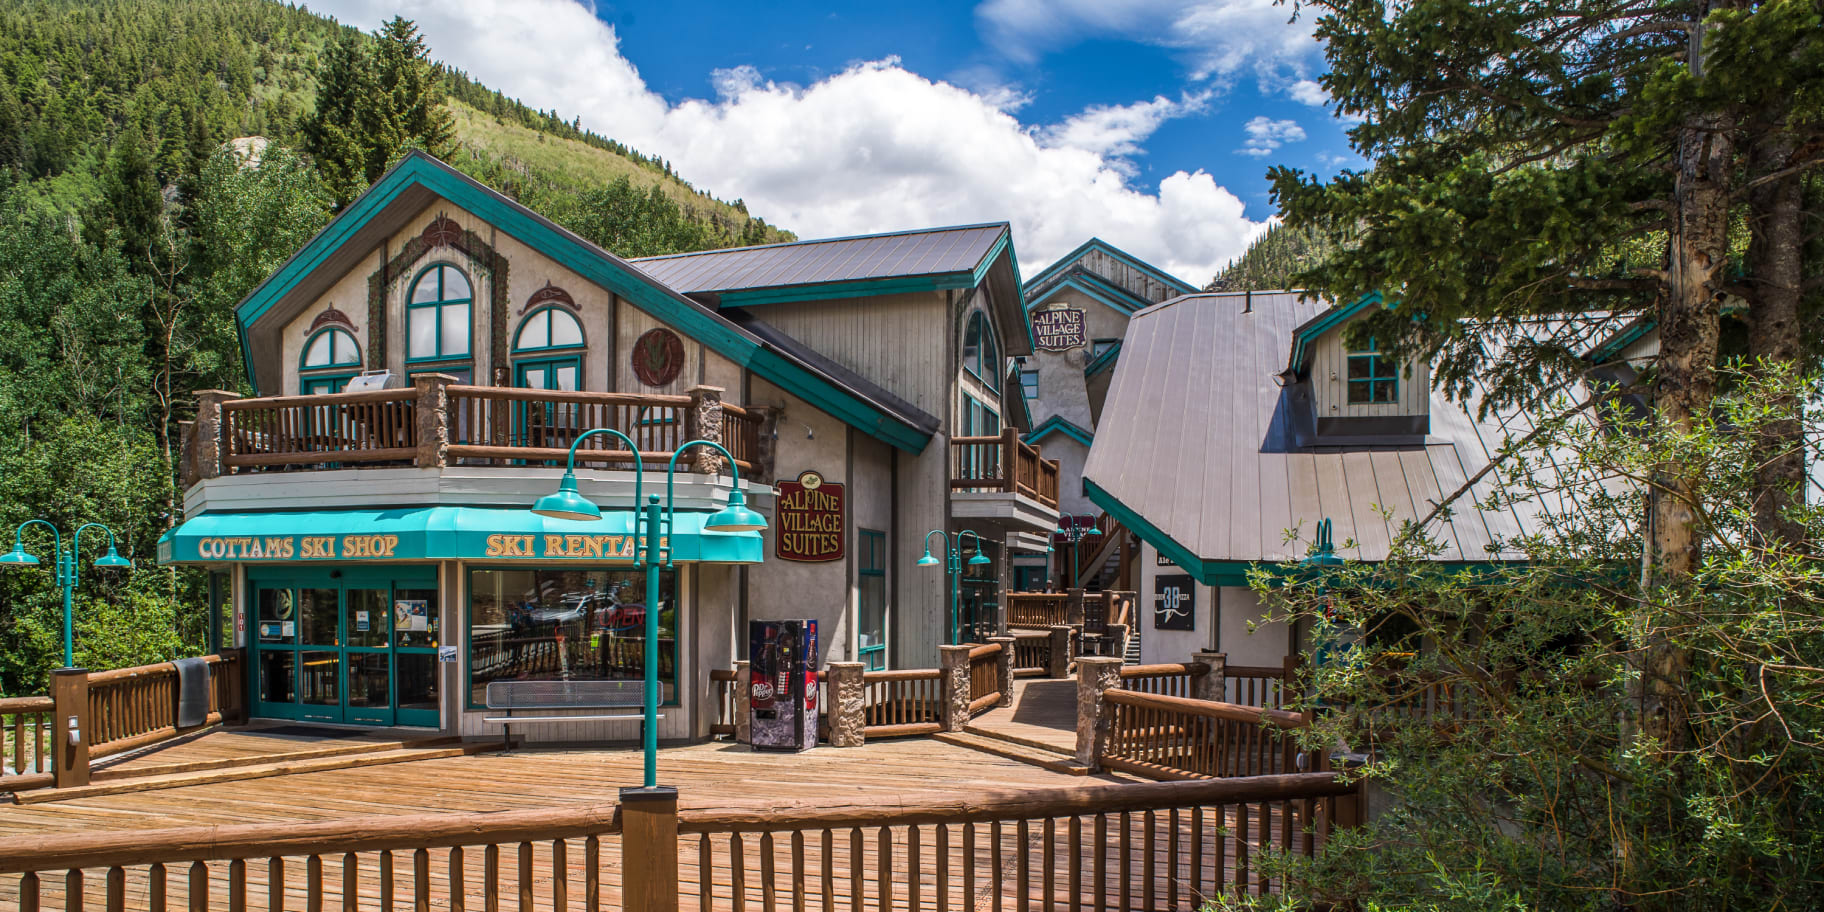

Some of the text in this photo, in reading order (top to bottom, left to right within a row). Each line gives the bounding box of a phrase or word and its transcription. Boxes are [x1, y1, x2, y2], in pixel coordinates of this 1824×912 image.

[1035, 311, 1080, 324] ALPINE
[1036, 323, 1080, 336] VILLAGE
[1039, 334, 1080, 346] SUITES
[781, 489, 839, 511] ALPINE
[781, 512, 841, 532] VILLAGE
[300, 536, 336, 558] SKI
[342, 534, 398, 557] SHOP
[486, 534, 535, 557] SKI
[783, 533, 838, 555] SUITES
[1164, 586, 1180, 608] 38
[599, 608, 646, 626] OPEN
